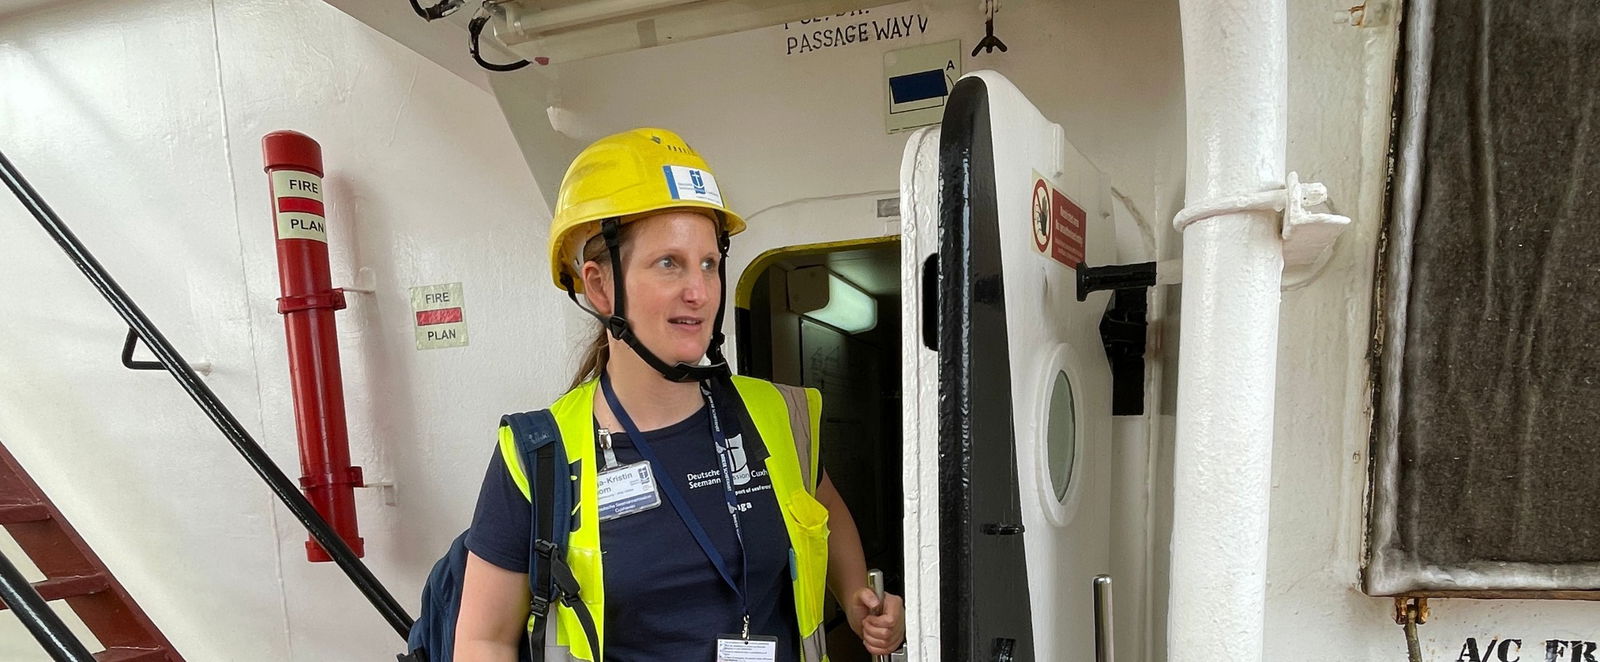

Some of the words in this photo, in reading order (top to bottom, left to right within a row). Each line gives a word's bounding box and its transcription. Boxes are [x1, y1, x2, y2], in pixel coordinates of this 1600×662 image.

[786, 22, 869, 55] PASSAGE
[872, 14, 914, 41] WAY
[946, 59, 955, 71] A
[289, 179, 319, 194] FIRE
[290, 218, 325, 233] PLAN
[425, 291, 450, 304] FIRE
[427, 328, 457, 341] PLAN
[687, 469, 720, 481] Deutsche
[689, 477, 721, 490] Seemann
[750, 470, 769, 478] Cuxh
